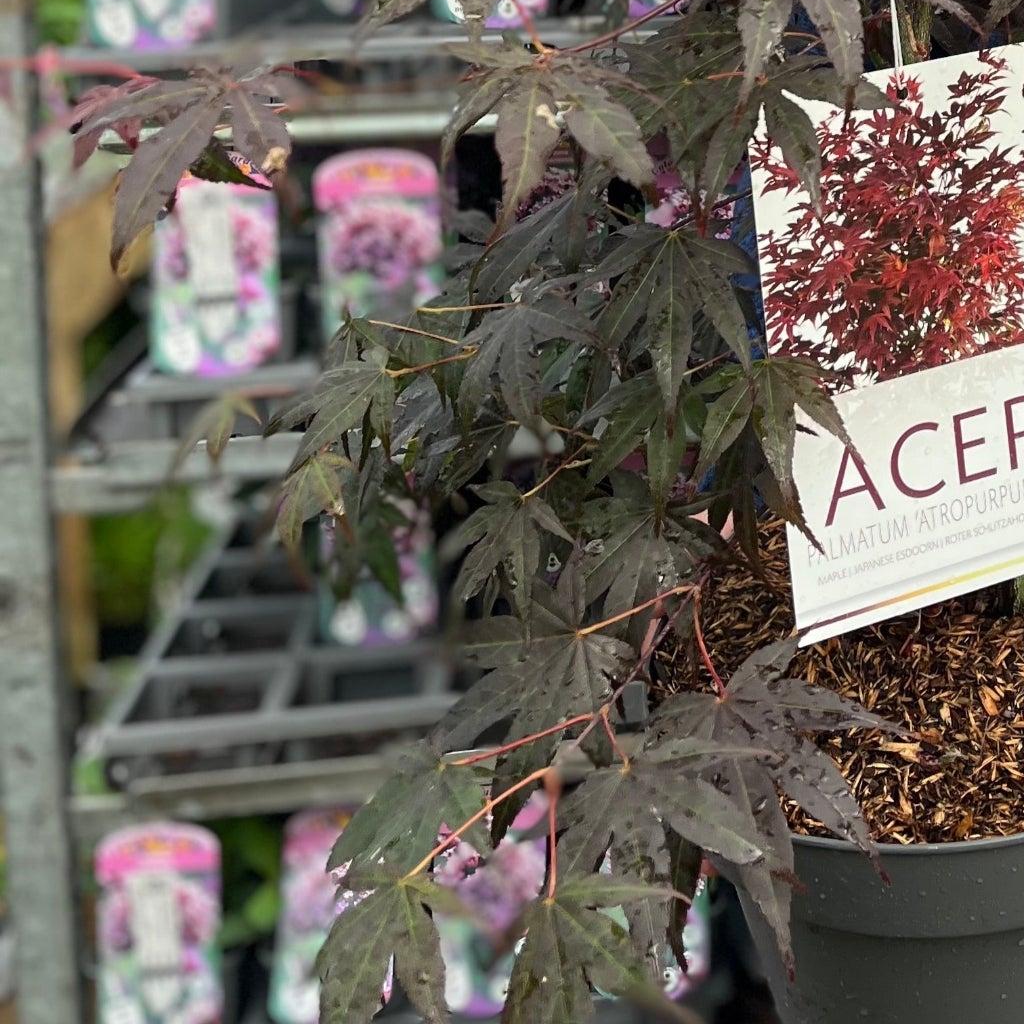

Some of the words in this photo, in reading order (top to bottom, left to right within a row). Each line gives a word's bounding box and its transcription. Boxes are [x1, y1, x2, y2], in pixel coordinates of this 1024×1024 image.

[817, 568, 847, 586] MAPLE
[896, 540, 940, 562] ESDOORN
[945, 526, 973, 545] ROTER
